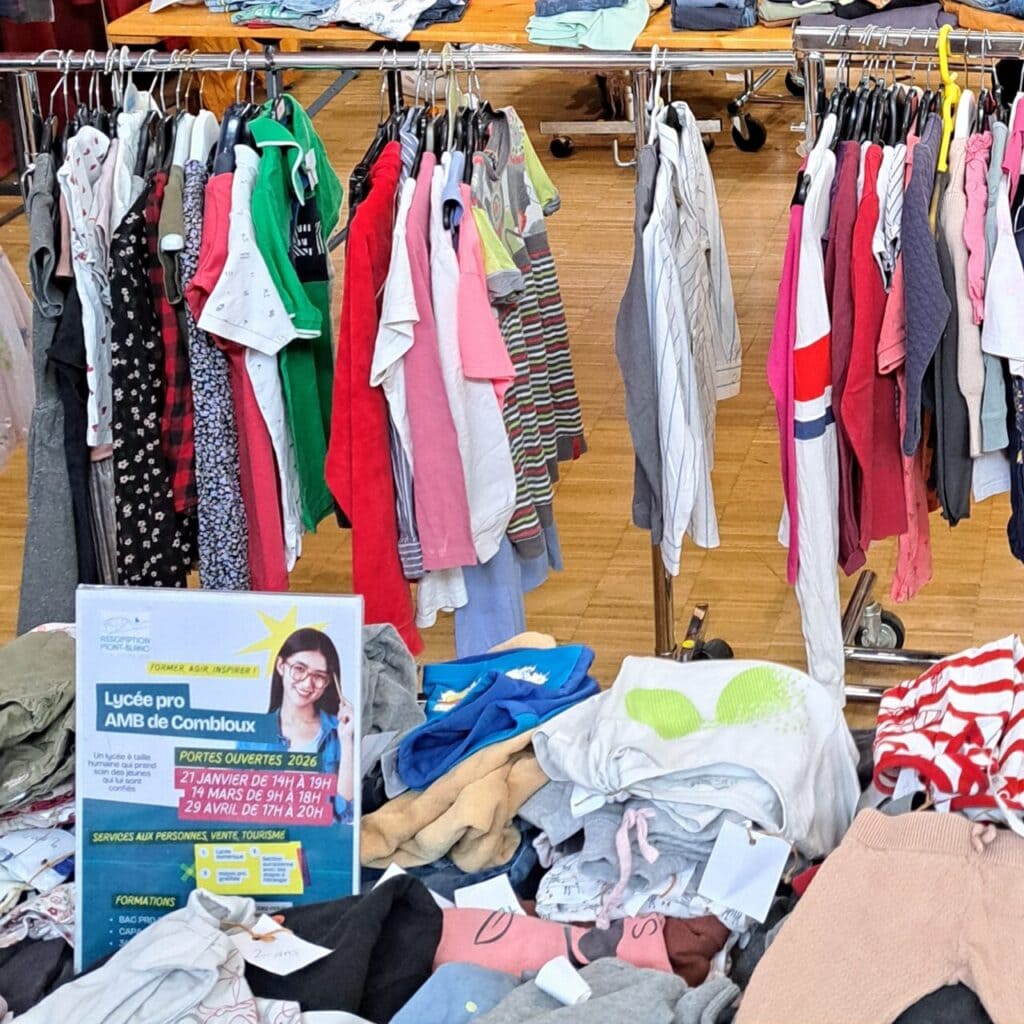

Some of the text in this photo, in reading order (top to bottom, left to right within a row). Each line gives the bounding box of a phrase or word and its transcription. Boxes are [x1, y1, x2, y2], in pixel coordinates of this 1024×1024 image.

[150, 664, 184, 672] FORMER
[188, 665, 211, 673] AGIR
[213, 665, 250, 674] INSPIRER
[104, 690, 185, 710] Lycée pro
[105, 713, 256, 733] AMB de Combloux
[179, 751, 318, 767] PORTES OUVERTES 2026
[180, 771, 195, 783] 21
[196, 773, 249, 786] JANVIER
[251, 775, 269, 787] DE
[272, 776, 295, 788] 14H
[309, 777, 332, 789] 19H
[191, 786, 204, 798] 14
[207, 788, 244, 801] MARS
[246, 789, 264, 801] DE
[266, 791, 284, 802] 9H
[299, 791, 322, 804] 18H
[184, 800, 202, 813] 29
[203, 803, 238, 815] AVRIL
[241, 804, 259, 816] DE
[262, 805, 283, 817] 17H
[296, 806, 324, 819] 20H
[92, 832, 135, 842] SERVICES
[136, 831, 154, 841] AUX
[241, 830, 286, 840] TOURISME
[115, 895, 176, 907] FORMATIONS
[119, 915, 137, 924] BAC
